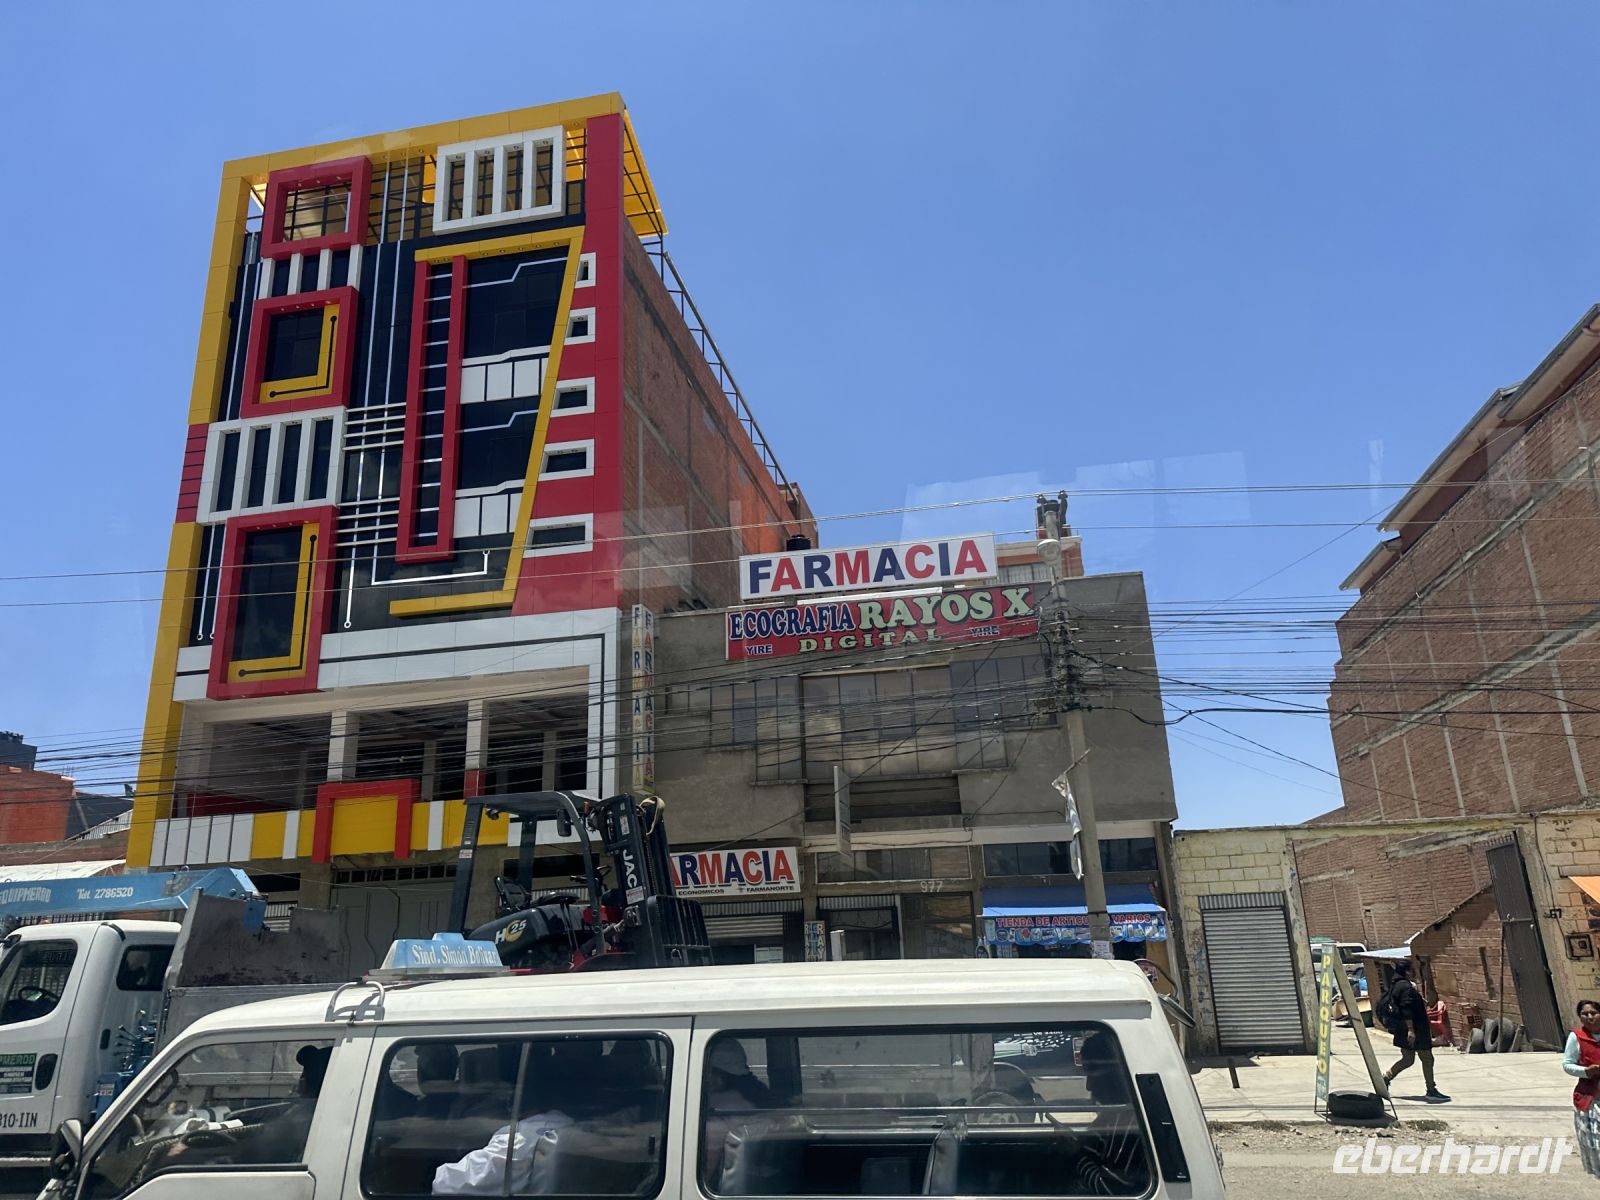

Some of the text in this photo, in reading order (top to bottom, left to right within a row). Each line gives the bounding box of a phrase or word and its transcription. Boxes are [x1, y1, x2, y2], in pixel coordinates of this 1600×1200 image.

[749, 539, 988, 594] FARMACIA
[729, 587, 1034, 640] ECOGRAFIA RAYOS X
[746, 643, 773, 656] YIRE
[798, 627, 943, 652] DIGITAL
[622, 849, 638, 888] JAC
[670, 849, 795, 887] ARMACIA
[94, 887, 134, 899] 2786520
[678, 888, 725, 896] ECONOMICOS
[996, 913, 1152, 927] TIENDA DE ARTICU VARIOS
[411, 943, 441, 965] Sind.
[1318, 954, 1331, 1074] PARQUEO
